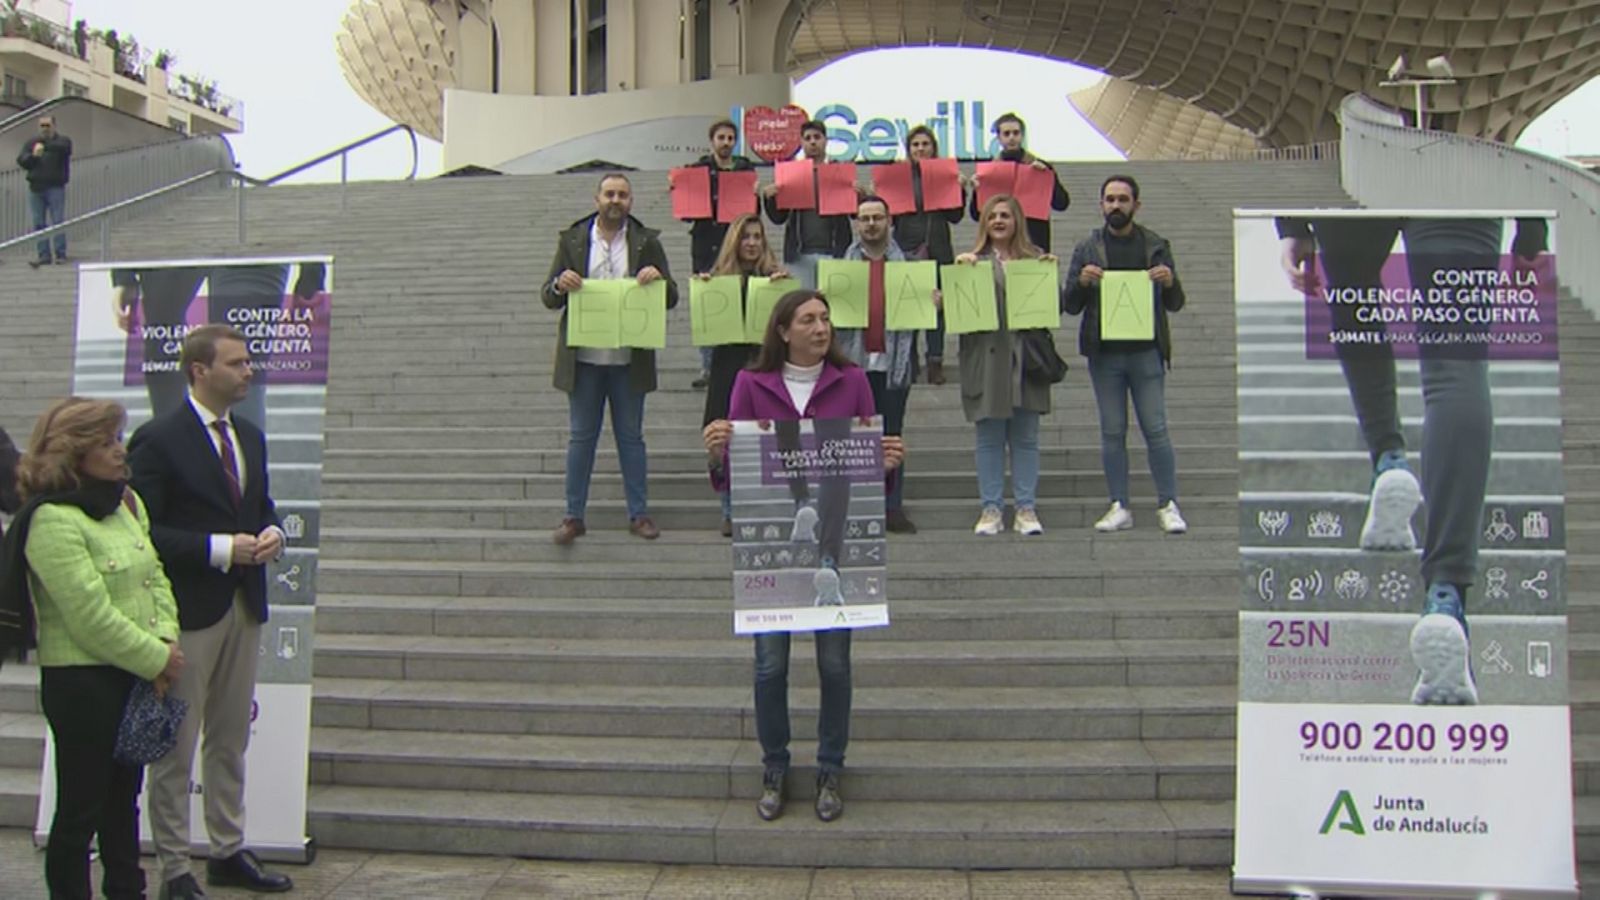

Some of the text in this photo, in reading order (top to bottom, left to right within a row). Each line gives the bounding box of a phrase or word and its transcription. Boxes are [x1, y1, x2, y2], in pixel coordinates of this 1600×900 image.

[1432, 270, 1538, 286] CONTRA LA
[1323, 286, 1539, 306] VIOLENCIA DE GÉNERO,
[227, 307, 313, 322] CONTRA LA
[1356, 308, 1540, 323] CADA PASO CUENTA
[1329, 330, 1381, 344] SÚMATE
[1383, 332, 1414, 344] PARA
[1464, 332, 1542, 344] AVANZANDO
[250, 339, 312, 353] CUENTA
[744, 576, 776, 590] 25N
[1267, 620, 1330, 647] 25N
[1299, 721, 1510, 752] 900 200 999
[1373, 795, 1425, 811] Junta
[1373, 815, 1489, 834] de Andalucía
